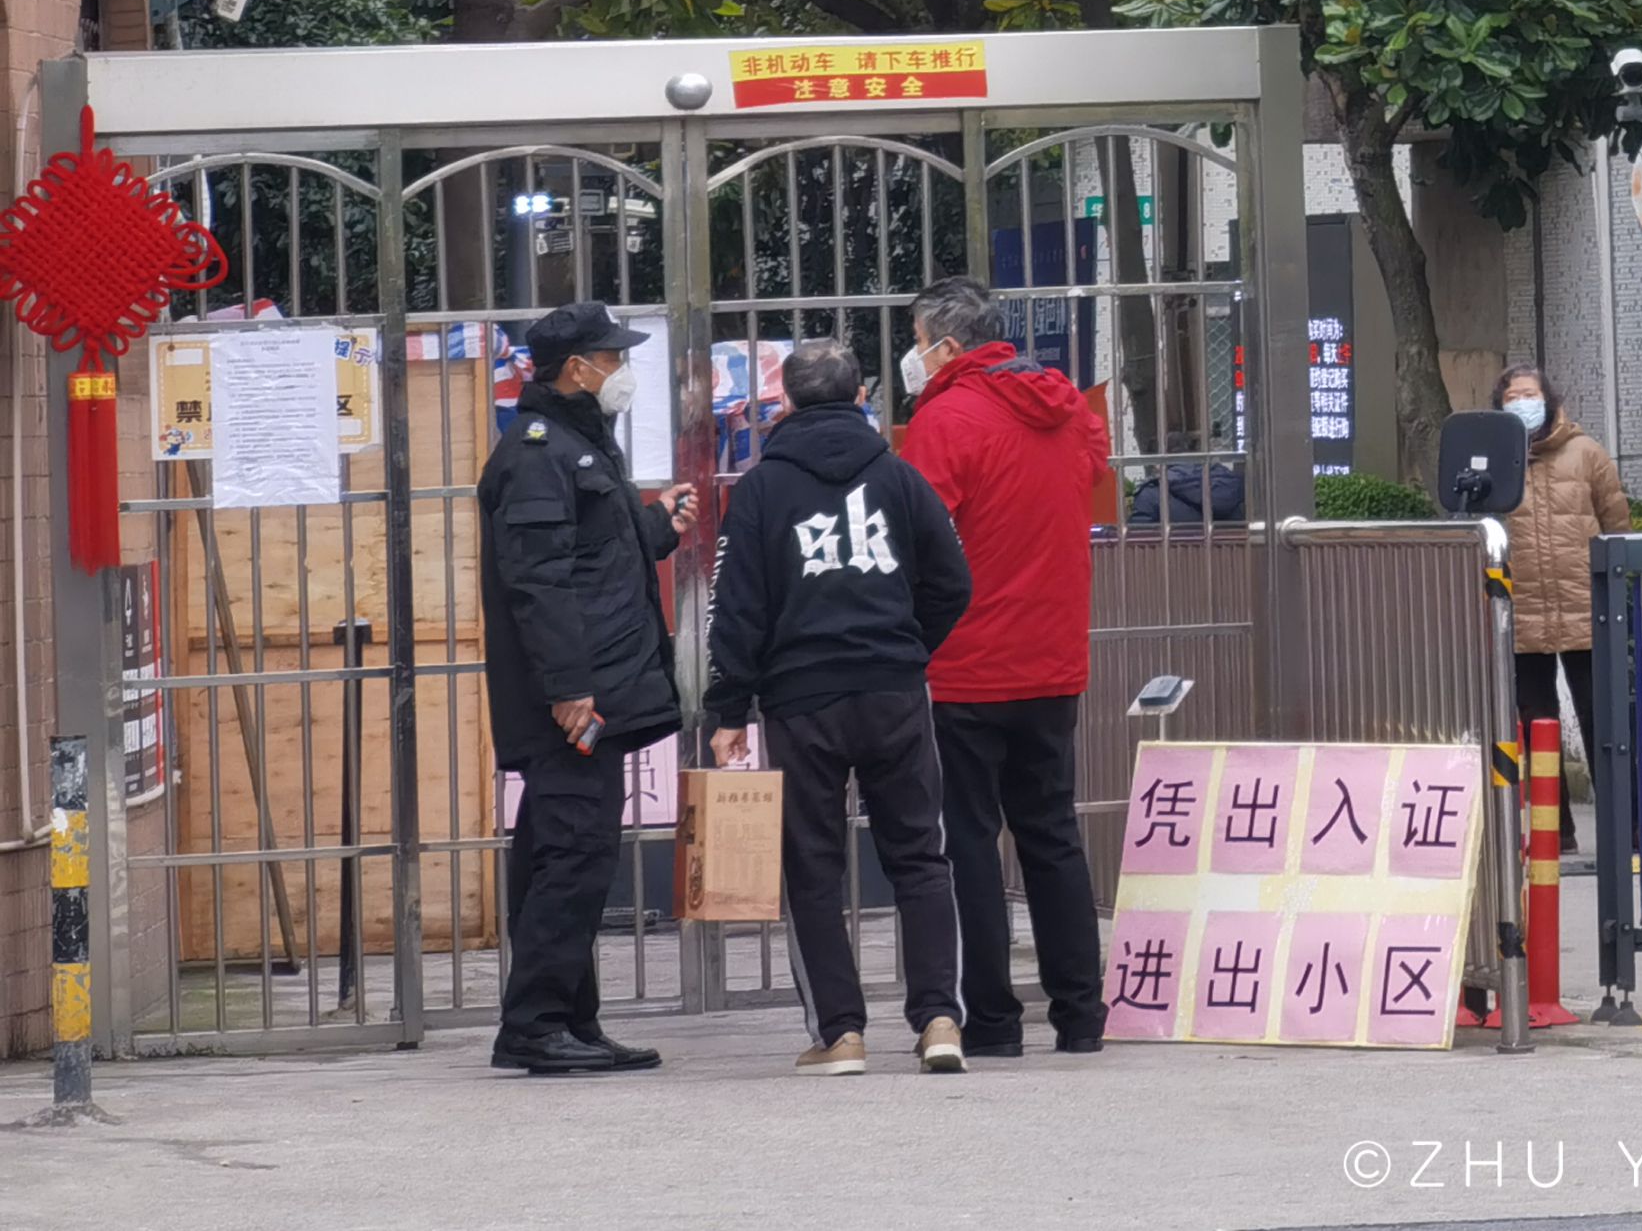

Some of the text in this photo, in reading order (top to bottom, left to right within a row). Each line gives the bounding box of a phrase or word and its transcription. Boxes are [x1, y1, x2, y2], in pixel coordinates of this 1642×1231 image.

[743, 47, 976, 75] 非机动车 请下车推行
[794, 76, 925, 99] 注意安全
[1135, 777, 1465, 848] 凭出入证
[1111, 939, 1442, 1015] 进出小区
